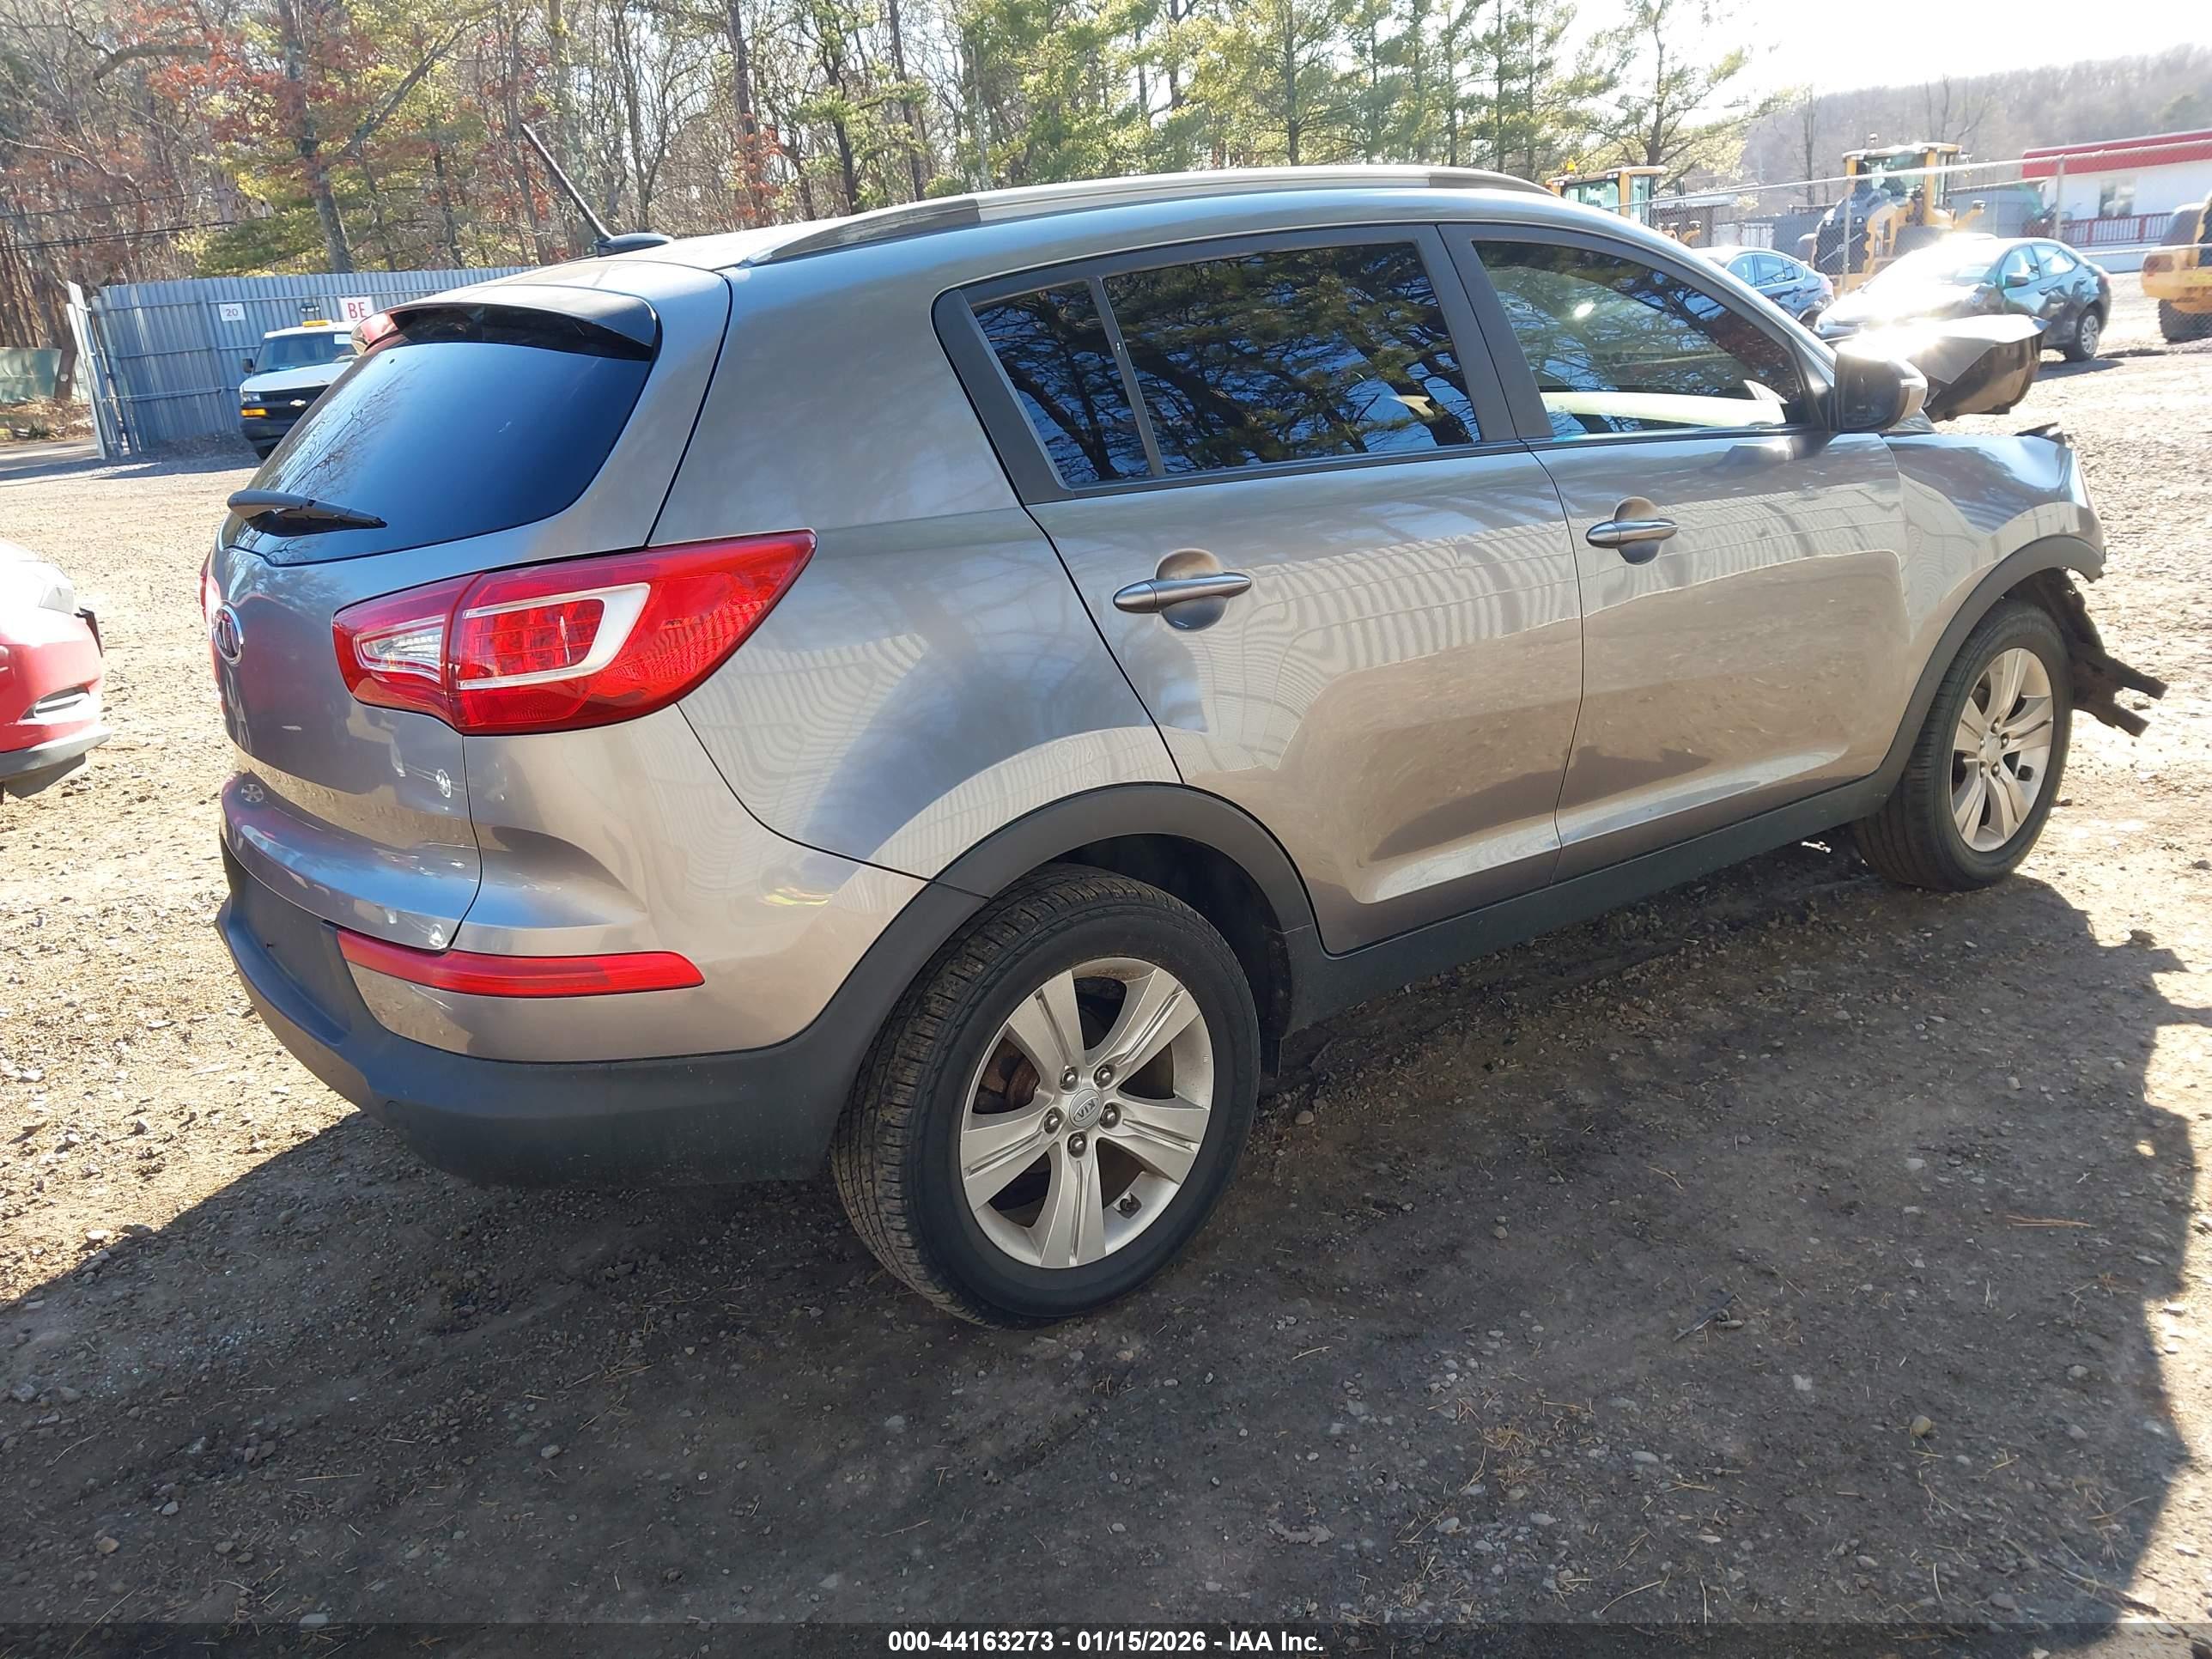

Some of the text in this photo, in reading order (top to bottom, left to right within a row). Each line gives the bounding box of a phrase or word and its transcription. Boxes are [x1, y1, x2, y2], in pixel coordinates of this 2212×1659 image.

[226, 308, 239, 317] 20
[347, 301, 367, 319] BE
[1077, 1098, 1097, 1118] KIA
